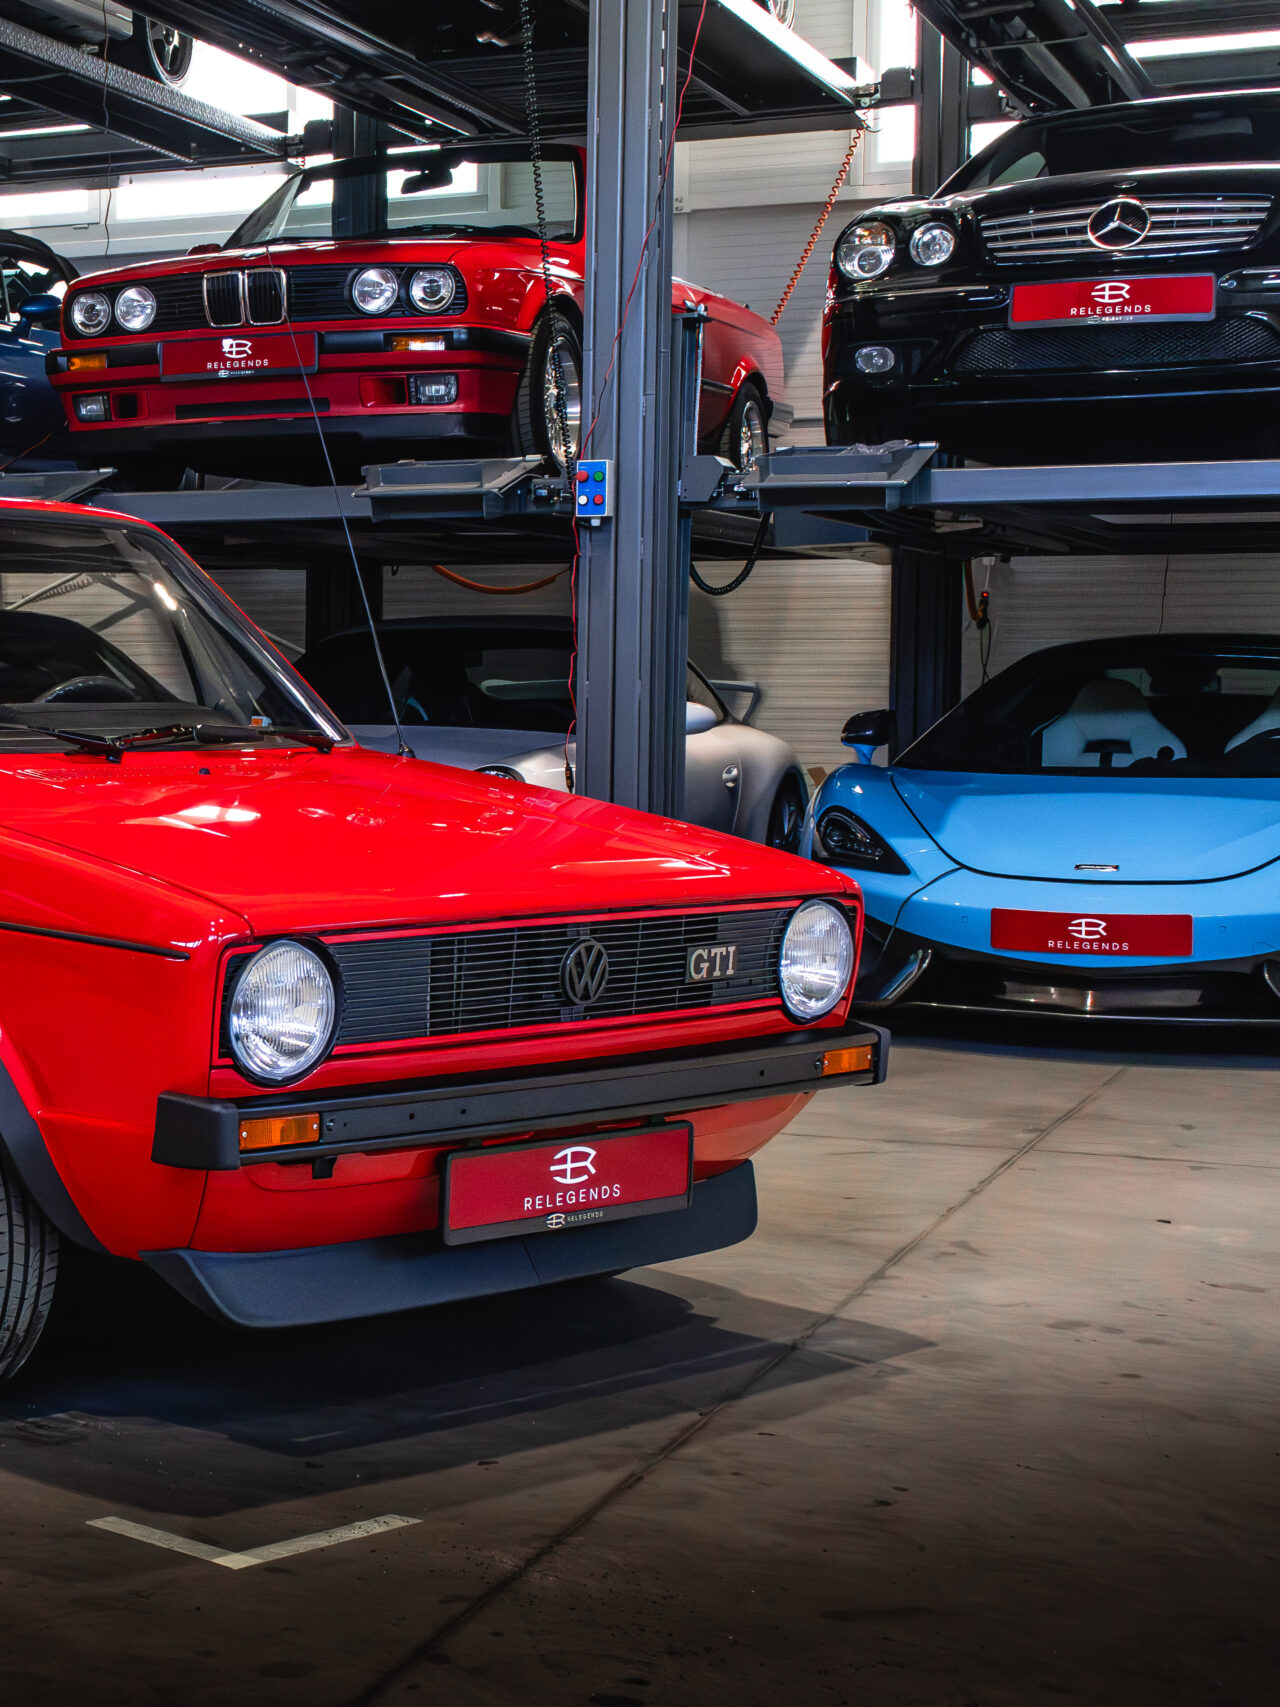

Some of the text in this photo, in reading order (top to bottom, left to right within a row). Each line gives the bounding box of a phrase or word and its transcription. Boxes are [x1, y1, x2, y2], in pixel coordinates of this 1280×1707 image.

[1070, 304, 1152, 316] RELEGENDS
[206, 359, 269, 369] RELEGENDS
[1047, 940, 1129, 950] RELEGENDS
[690, 945, 736, 980] GTI
[523, 1183, 621, 1211] RELEGENDS
